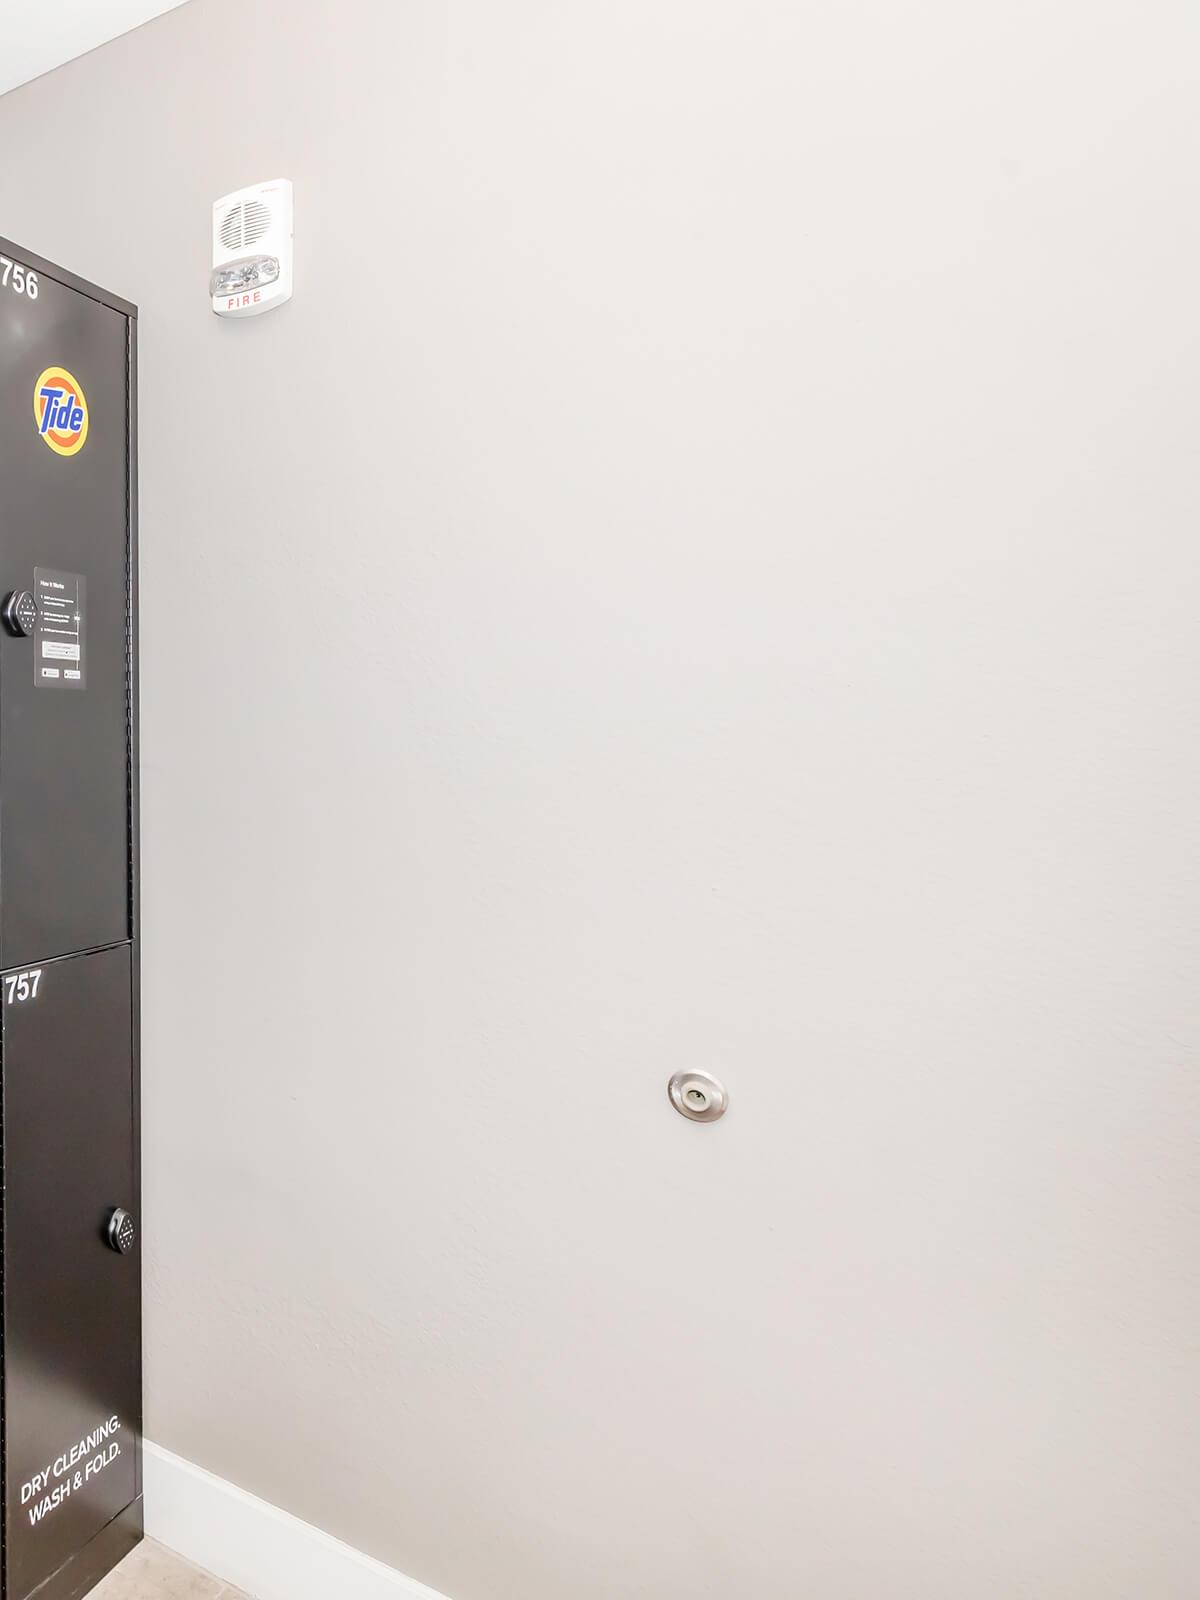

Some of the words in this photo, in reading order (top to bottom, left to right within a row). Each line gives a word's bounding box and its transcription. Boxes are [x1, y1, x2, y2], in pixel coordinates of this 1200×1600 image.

[0, 257, 39, 300] 756
[228, 291, 262, 310] FIRE
[39, 387, 84, 435] Tide
[5, 969, 42, 1004] 757
[21, 1465, 51, 1504] DRY
[53, 1415, 121, 1477] CLEANING.
[29, 1479, 71, 1525] WASH
[73, 1471, 83, 1490] &
[85, 1442, 121, 1481] FOLD.
